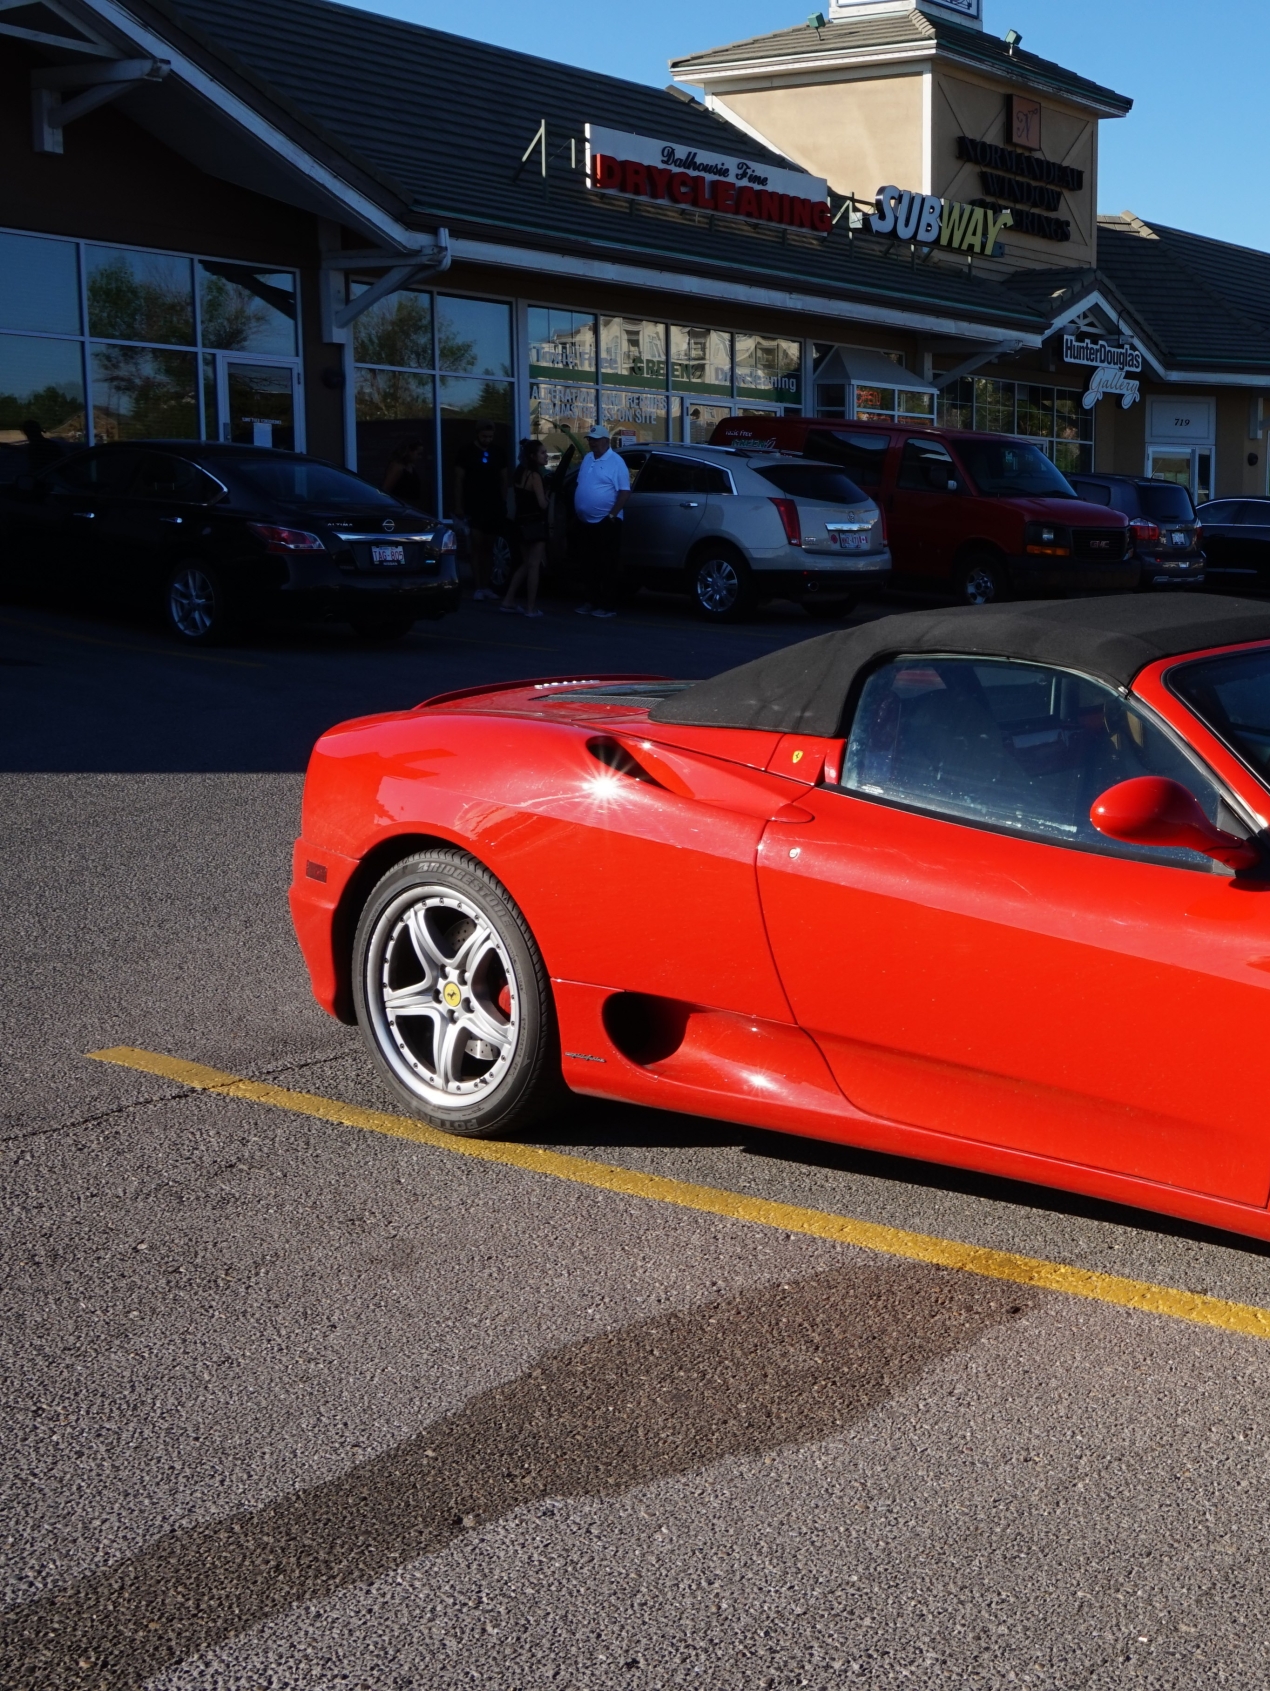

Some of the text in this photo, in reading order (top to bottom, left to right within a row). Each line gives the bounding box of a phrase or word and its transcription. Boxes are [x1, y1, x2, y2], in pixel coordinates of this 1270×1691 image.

[661, 146, 769, 187] Dalhousie Fine
[956, 136, 1084, 191] NORMANDEAU
[592, 153, 833, 233] DRYCLEANING
[978, 171, 1062, 211] WINDOW
[869, 185, 1014, 256] SUBWAY
[632, 356, 691, 379] GREEN
[1083, 367, 1140, 407] Gallery
[532, 386, 598, 404] ALTERATION
[635, 409, 657, 425] SITE
[1174, 418, 1190, 427] 719
[1089, 540, 1110, 549] GMC
[417, 862, 513, 927] BRIDGESTONE
